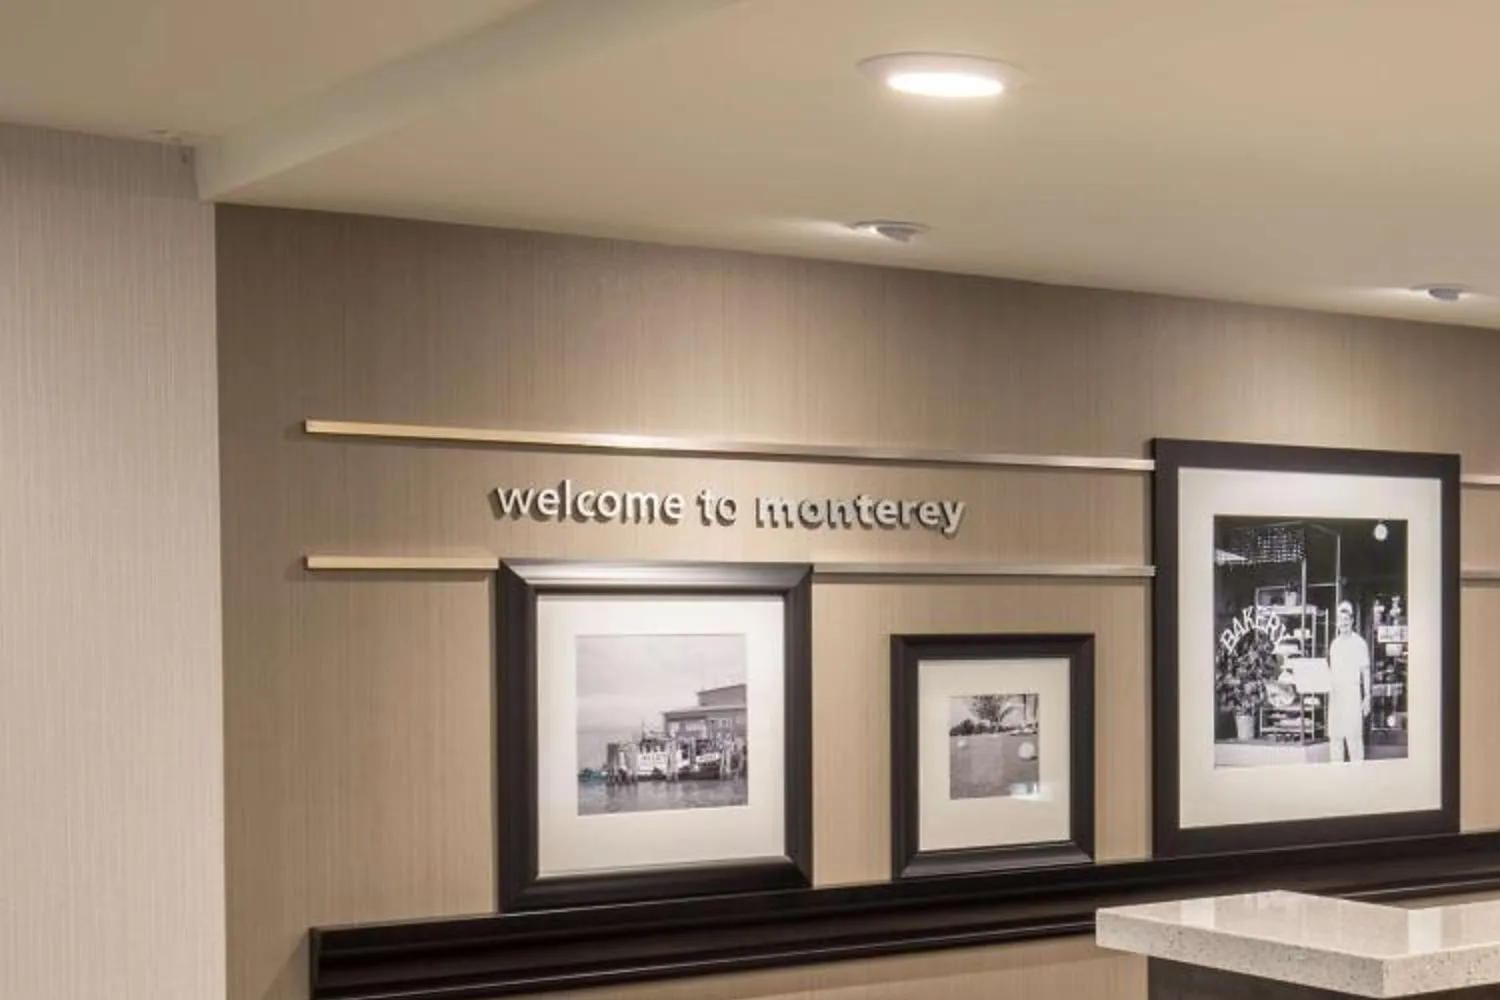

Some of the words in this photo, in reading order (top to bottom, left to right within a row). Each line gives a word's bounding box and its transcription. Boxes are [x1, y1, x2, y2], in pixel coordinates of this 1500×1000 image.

[494, 479, 684, 522] welcome
[697, 489, 738, 526] to
[755, 493, 966, 535] monterey
